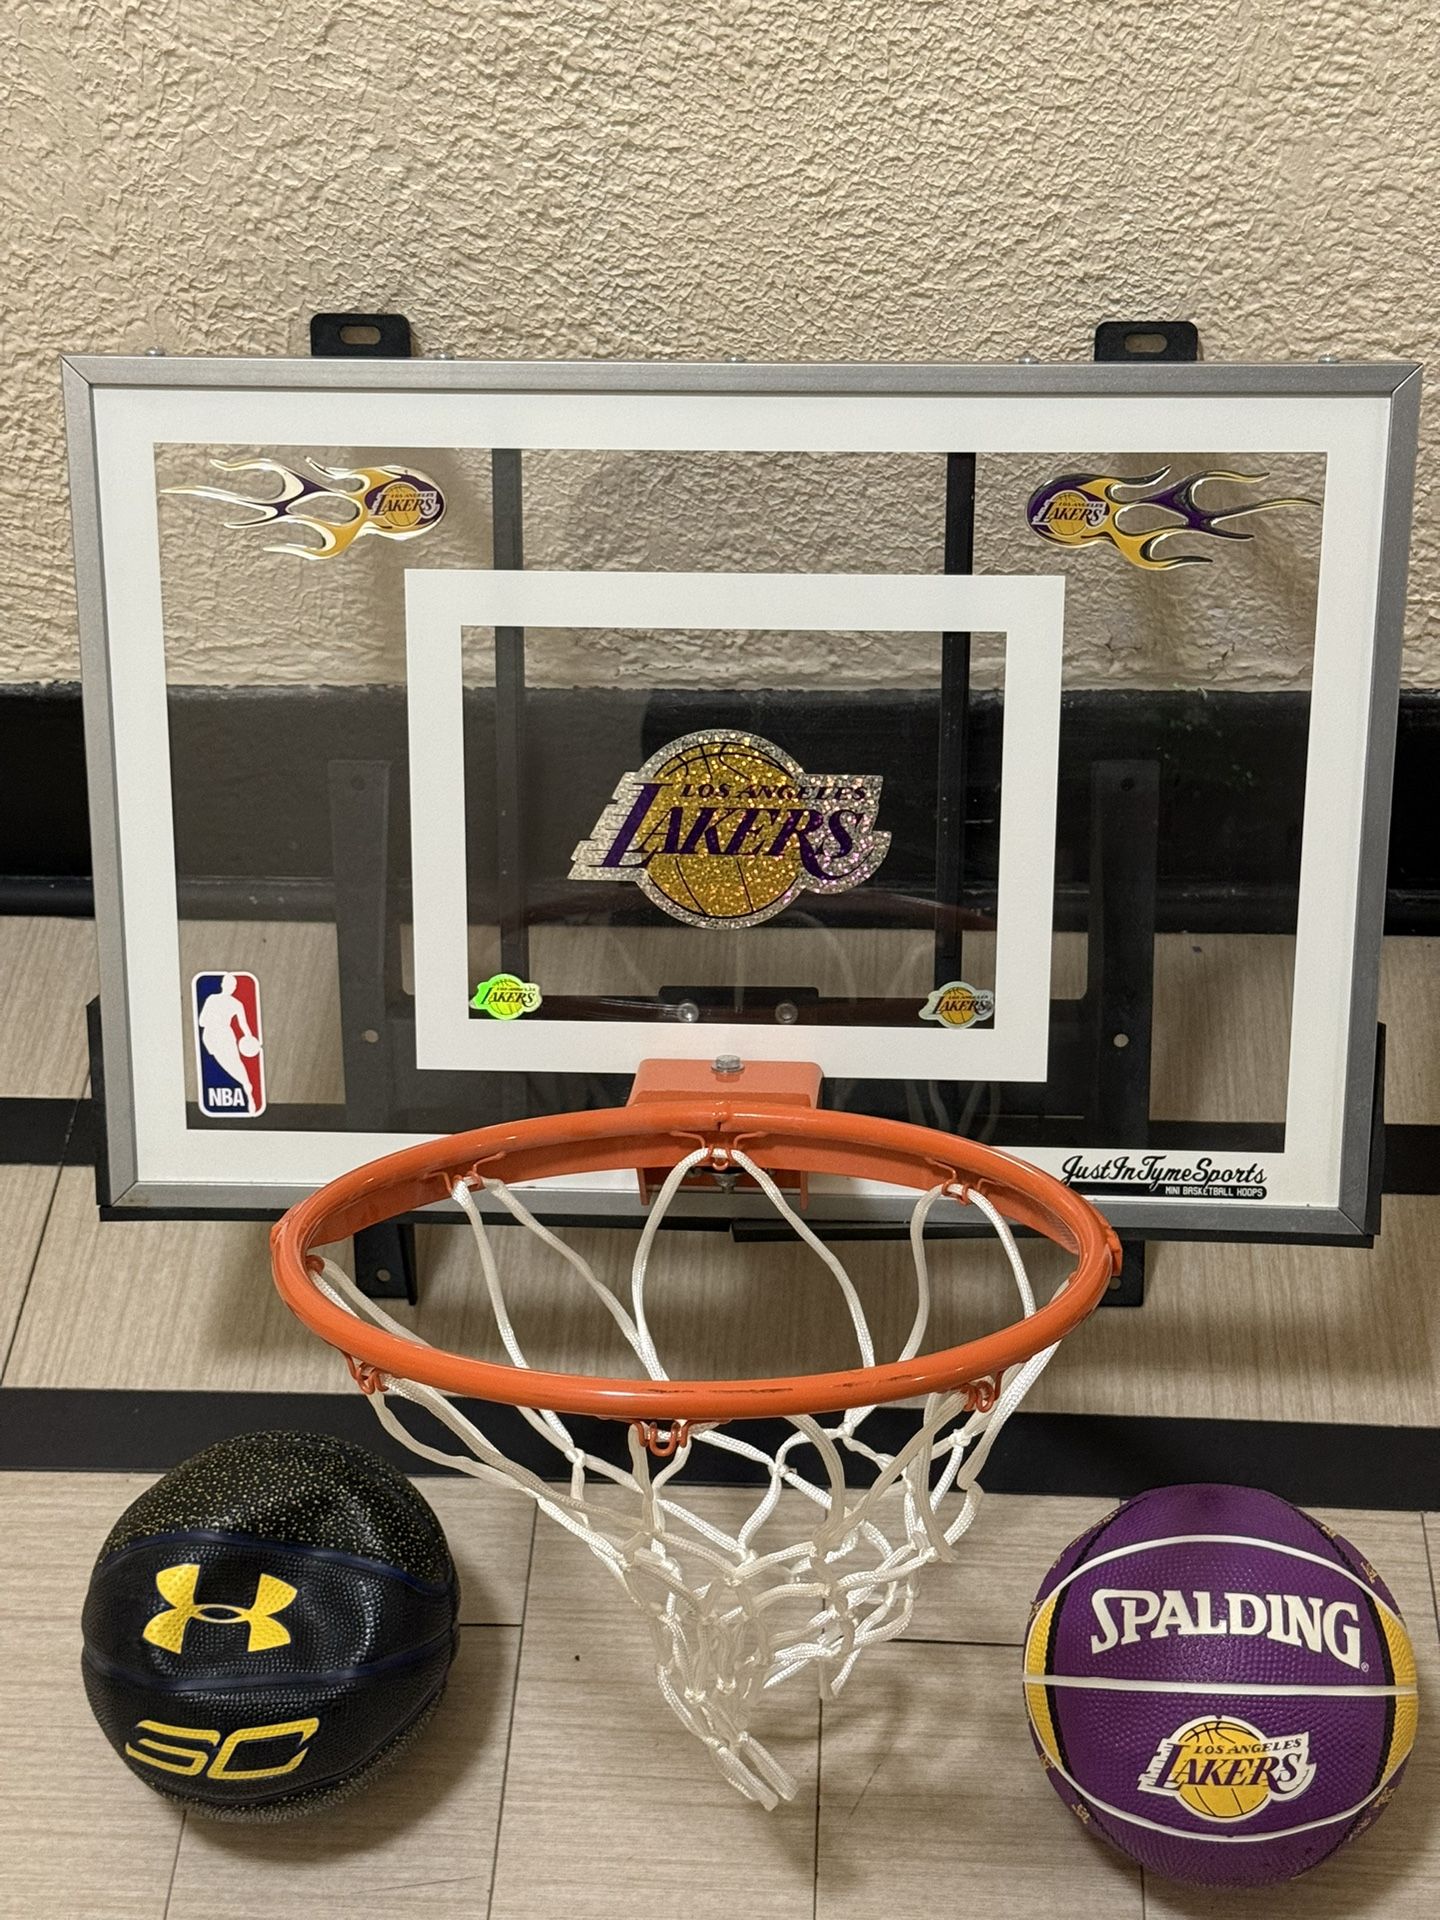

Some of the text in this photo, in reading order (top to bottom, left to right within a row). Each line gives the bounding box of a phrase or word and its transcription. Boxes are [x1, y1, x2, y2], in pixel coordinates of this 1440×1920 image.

[373, 494, 437, 517] LAKERS
[1038, 501, 1104, 527] LAKERS
[680, 784, 867, 801] LOS ANGELES
[589, 782, 874, 881] LAKERS
[480, 986, 536, 1008] LAKERS
[930, 996, 989, 1016] LAKERS
[208, 1087, 246, 1107] NBA
[1165, 1185, 1263, 1197] MINI BASKETBALL HOOPS
[1091, 1588, 1361, 1669] SPALDING
[1194, 1738, 1303, 1755] LOS ANGELES
[1150, 1743, 1309, 1794] LAKERS
